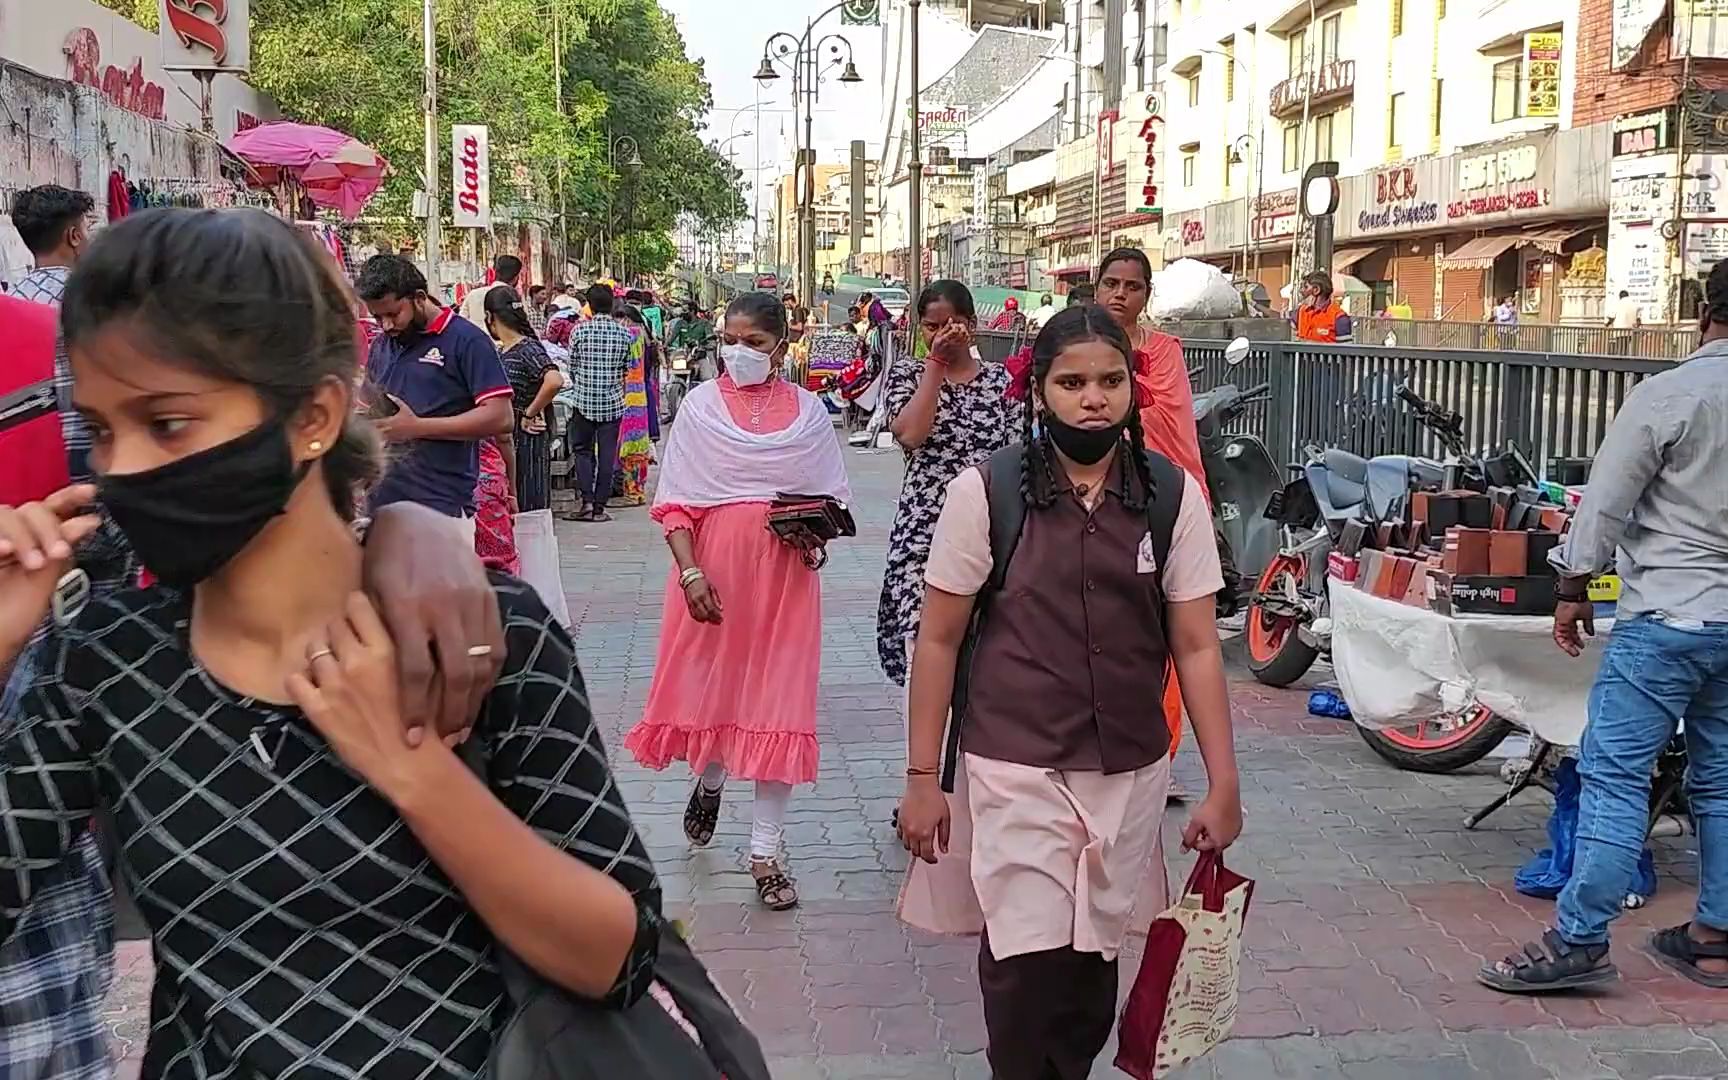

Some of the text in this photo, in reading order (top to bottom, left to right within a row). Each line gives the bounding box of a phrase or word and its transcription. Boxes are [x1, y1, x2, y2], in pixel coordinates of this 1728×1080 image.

[459, 135, 480, 217] Bata
[1376, 167, 1418, 205] BKR
[1479, 587, 1500, 602] high
